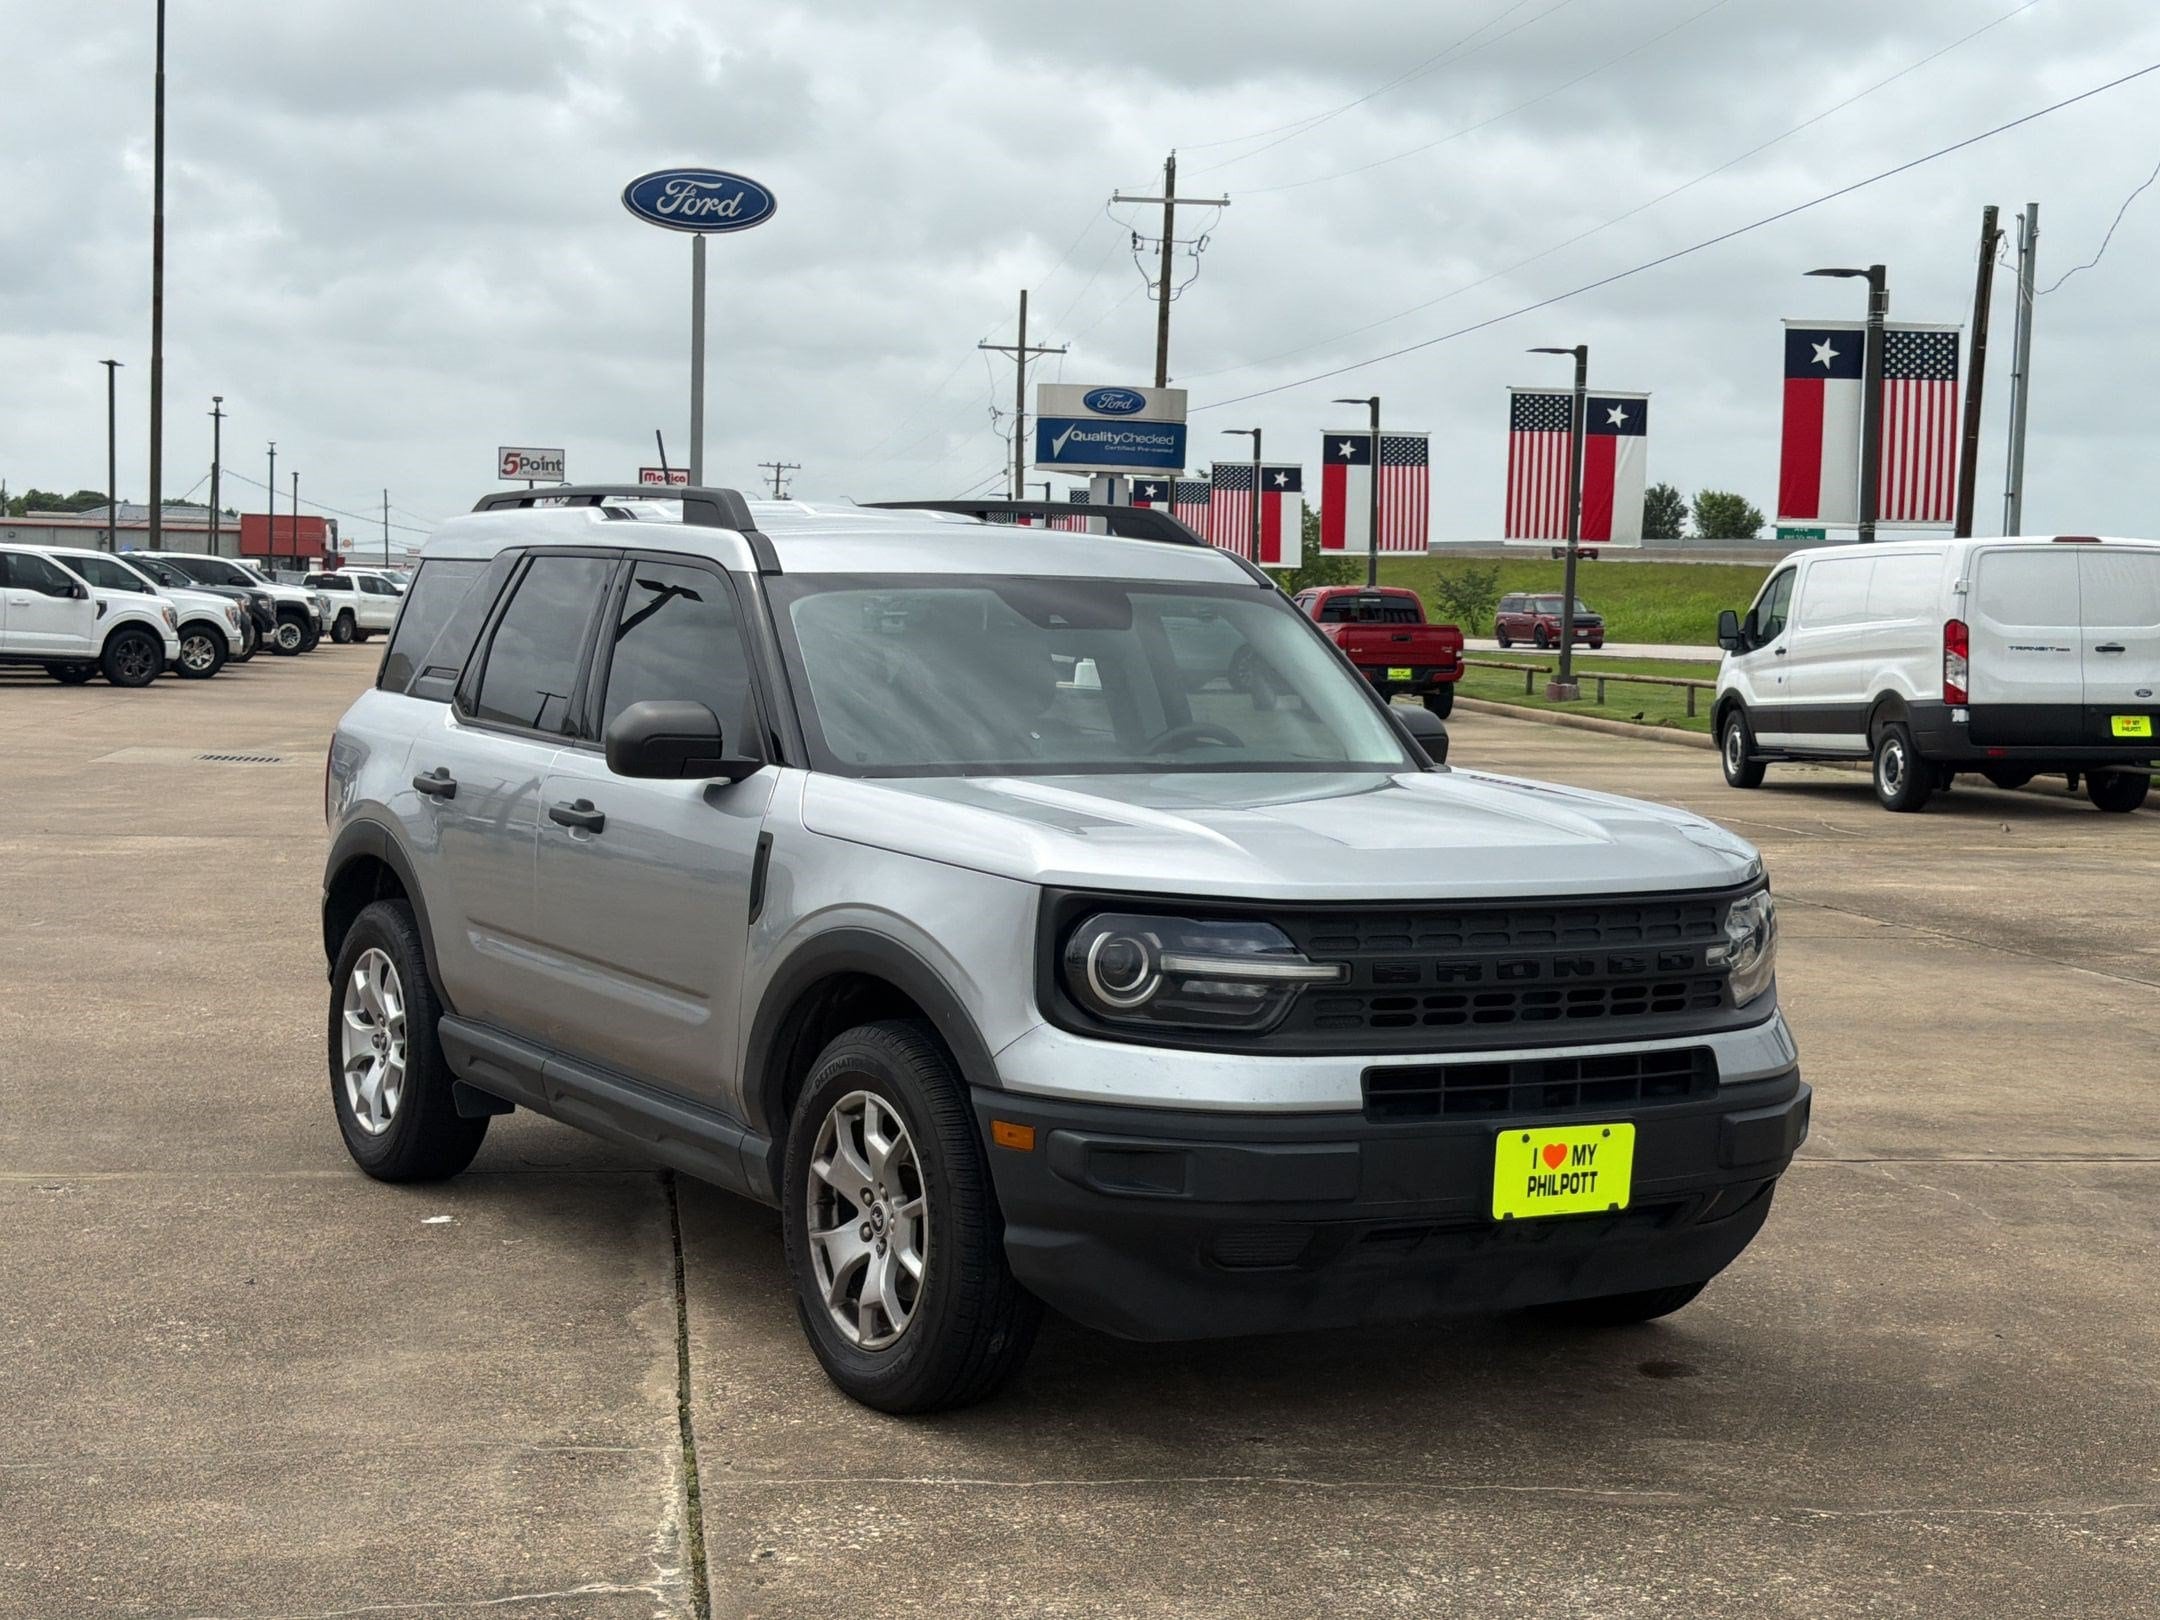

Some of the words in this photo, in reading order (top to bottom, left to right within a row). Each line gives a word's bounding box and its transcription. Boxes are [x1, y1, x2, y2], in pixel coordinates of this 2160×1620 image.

[655, 178, 745, 219] Ford
[1096, 392, 1133, 410] Ford
[1070, 430, 1174, 446] QualityChecked
[1372, 948, 1696, 985] BRONCO
[1532, 1147, 1538, 1170] I
[1571, 1143, 1598, 1167] MY
[1527, 1170, 1598, 1198] PHILPOTT
